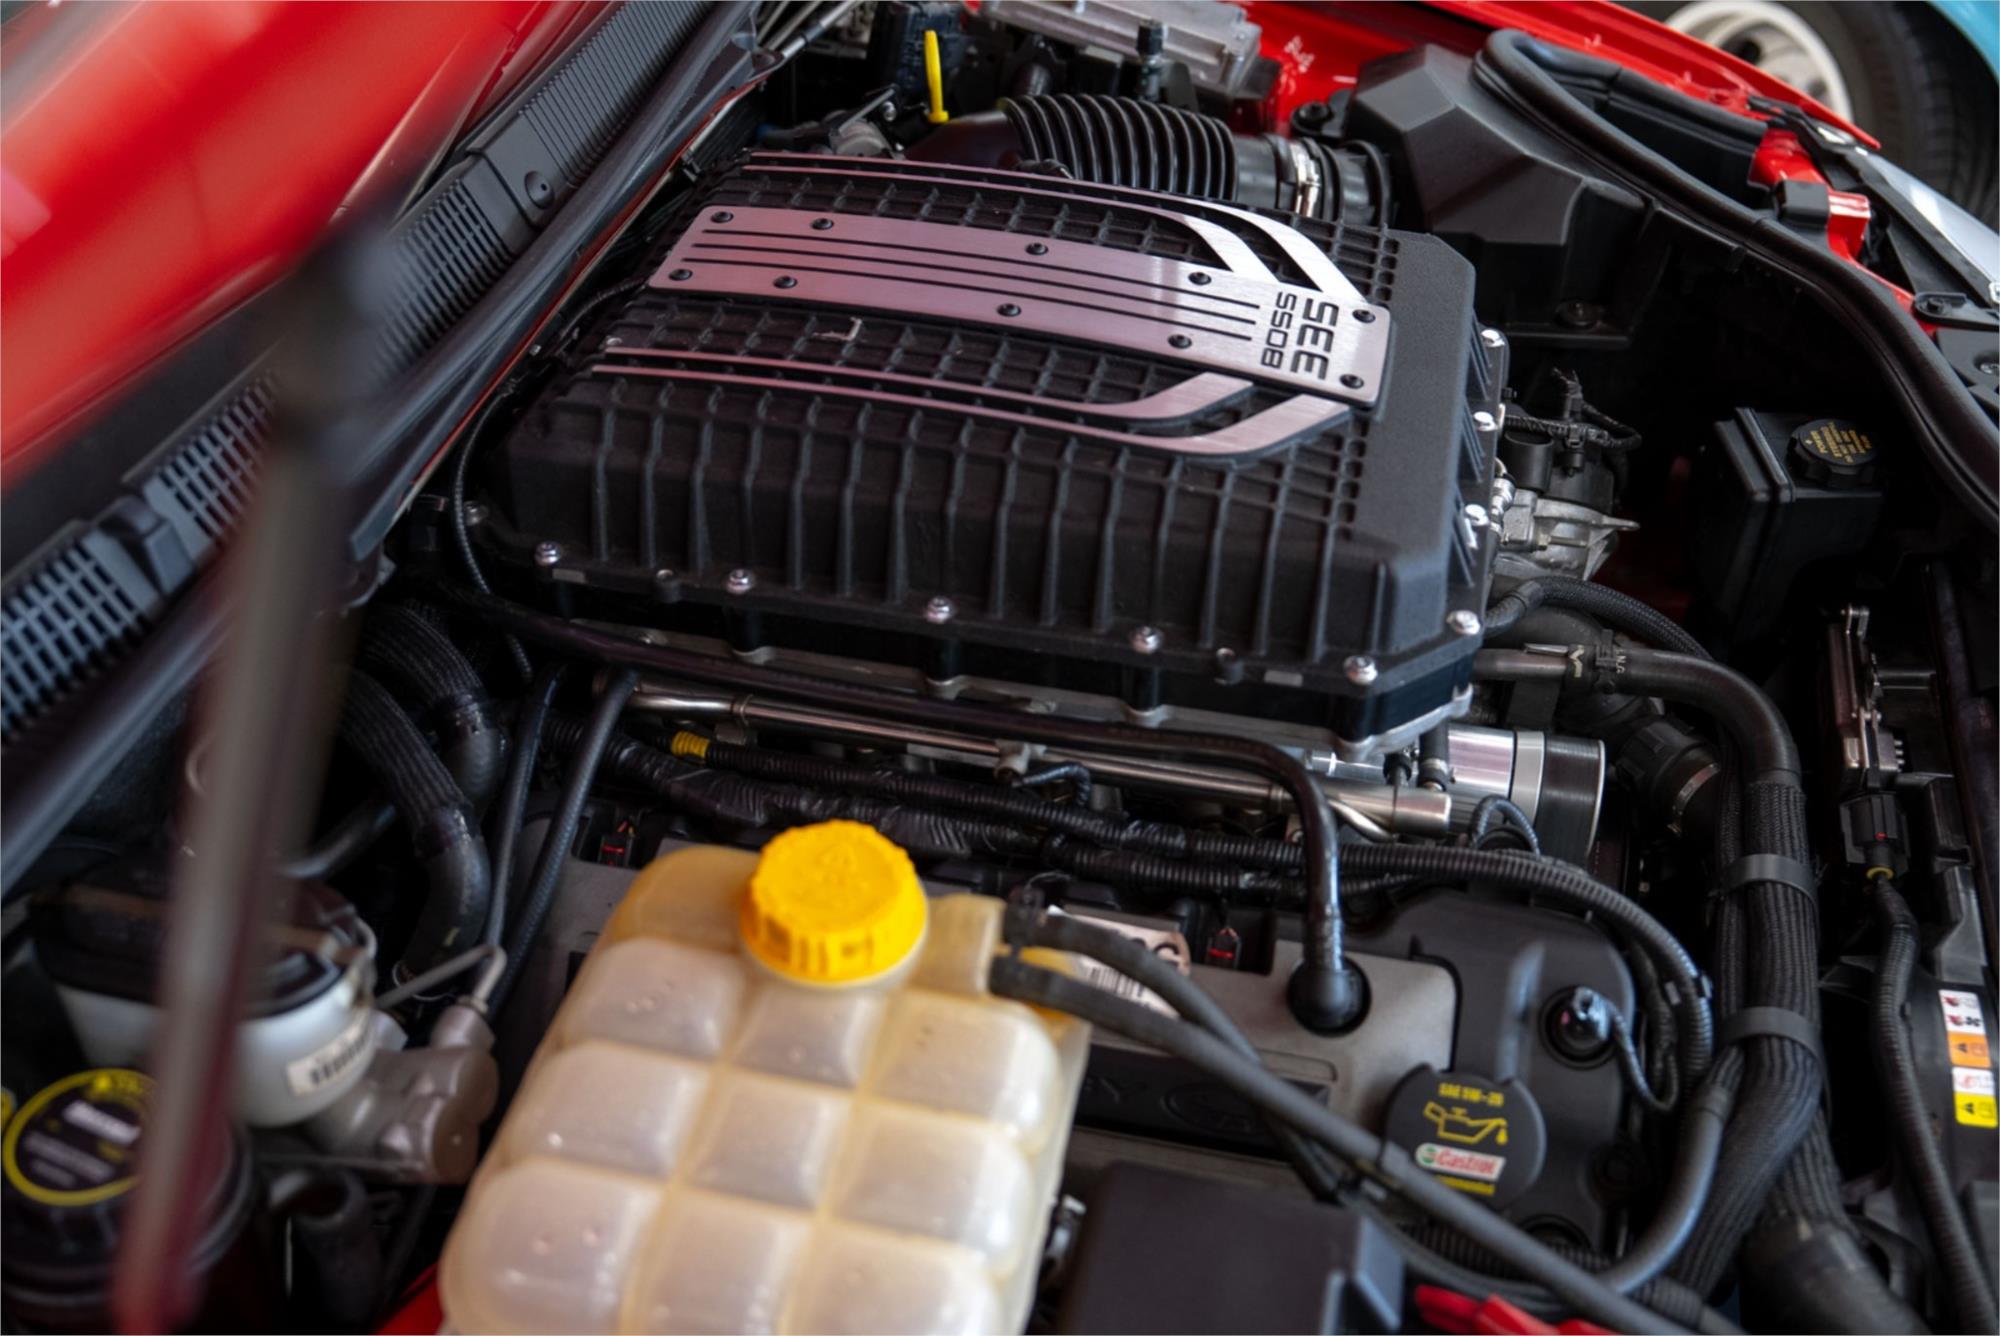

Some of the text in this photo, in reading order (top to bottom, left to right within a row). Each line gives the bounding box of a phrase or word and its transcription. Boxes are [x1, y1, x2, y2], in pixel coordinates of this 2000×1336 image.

[1260, 291, 1298, 370] BOSS
[1290, 298, 1340, 381] 335
[1436, 1149, 1495, 1174] Castrol
